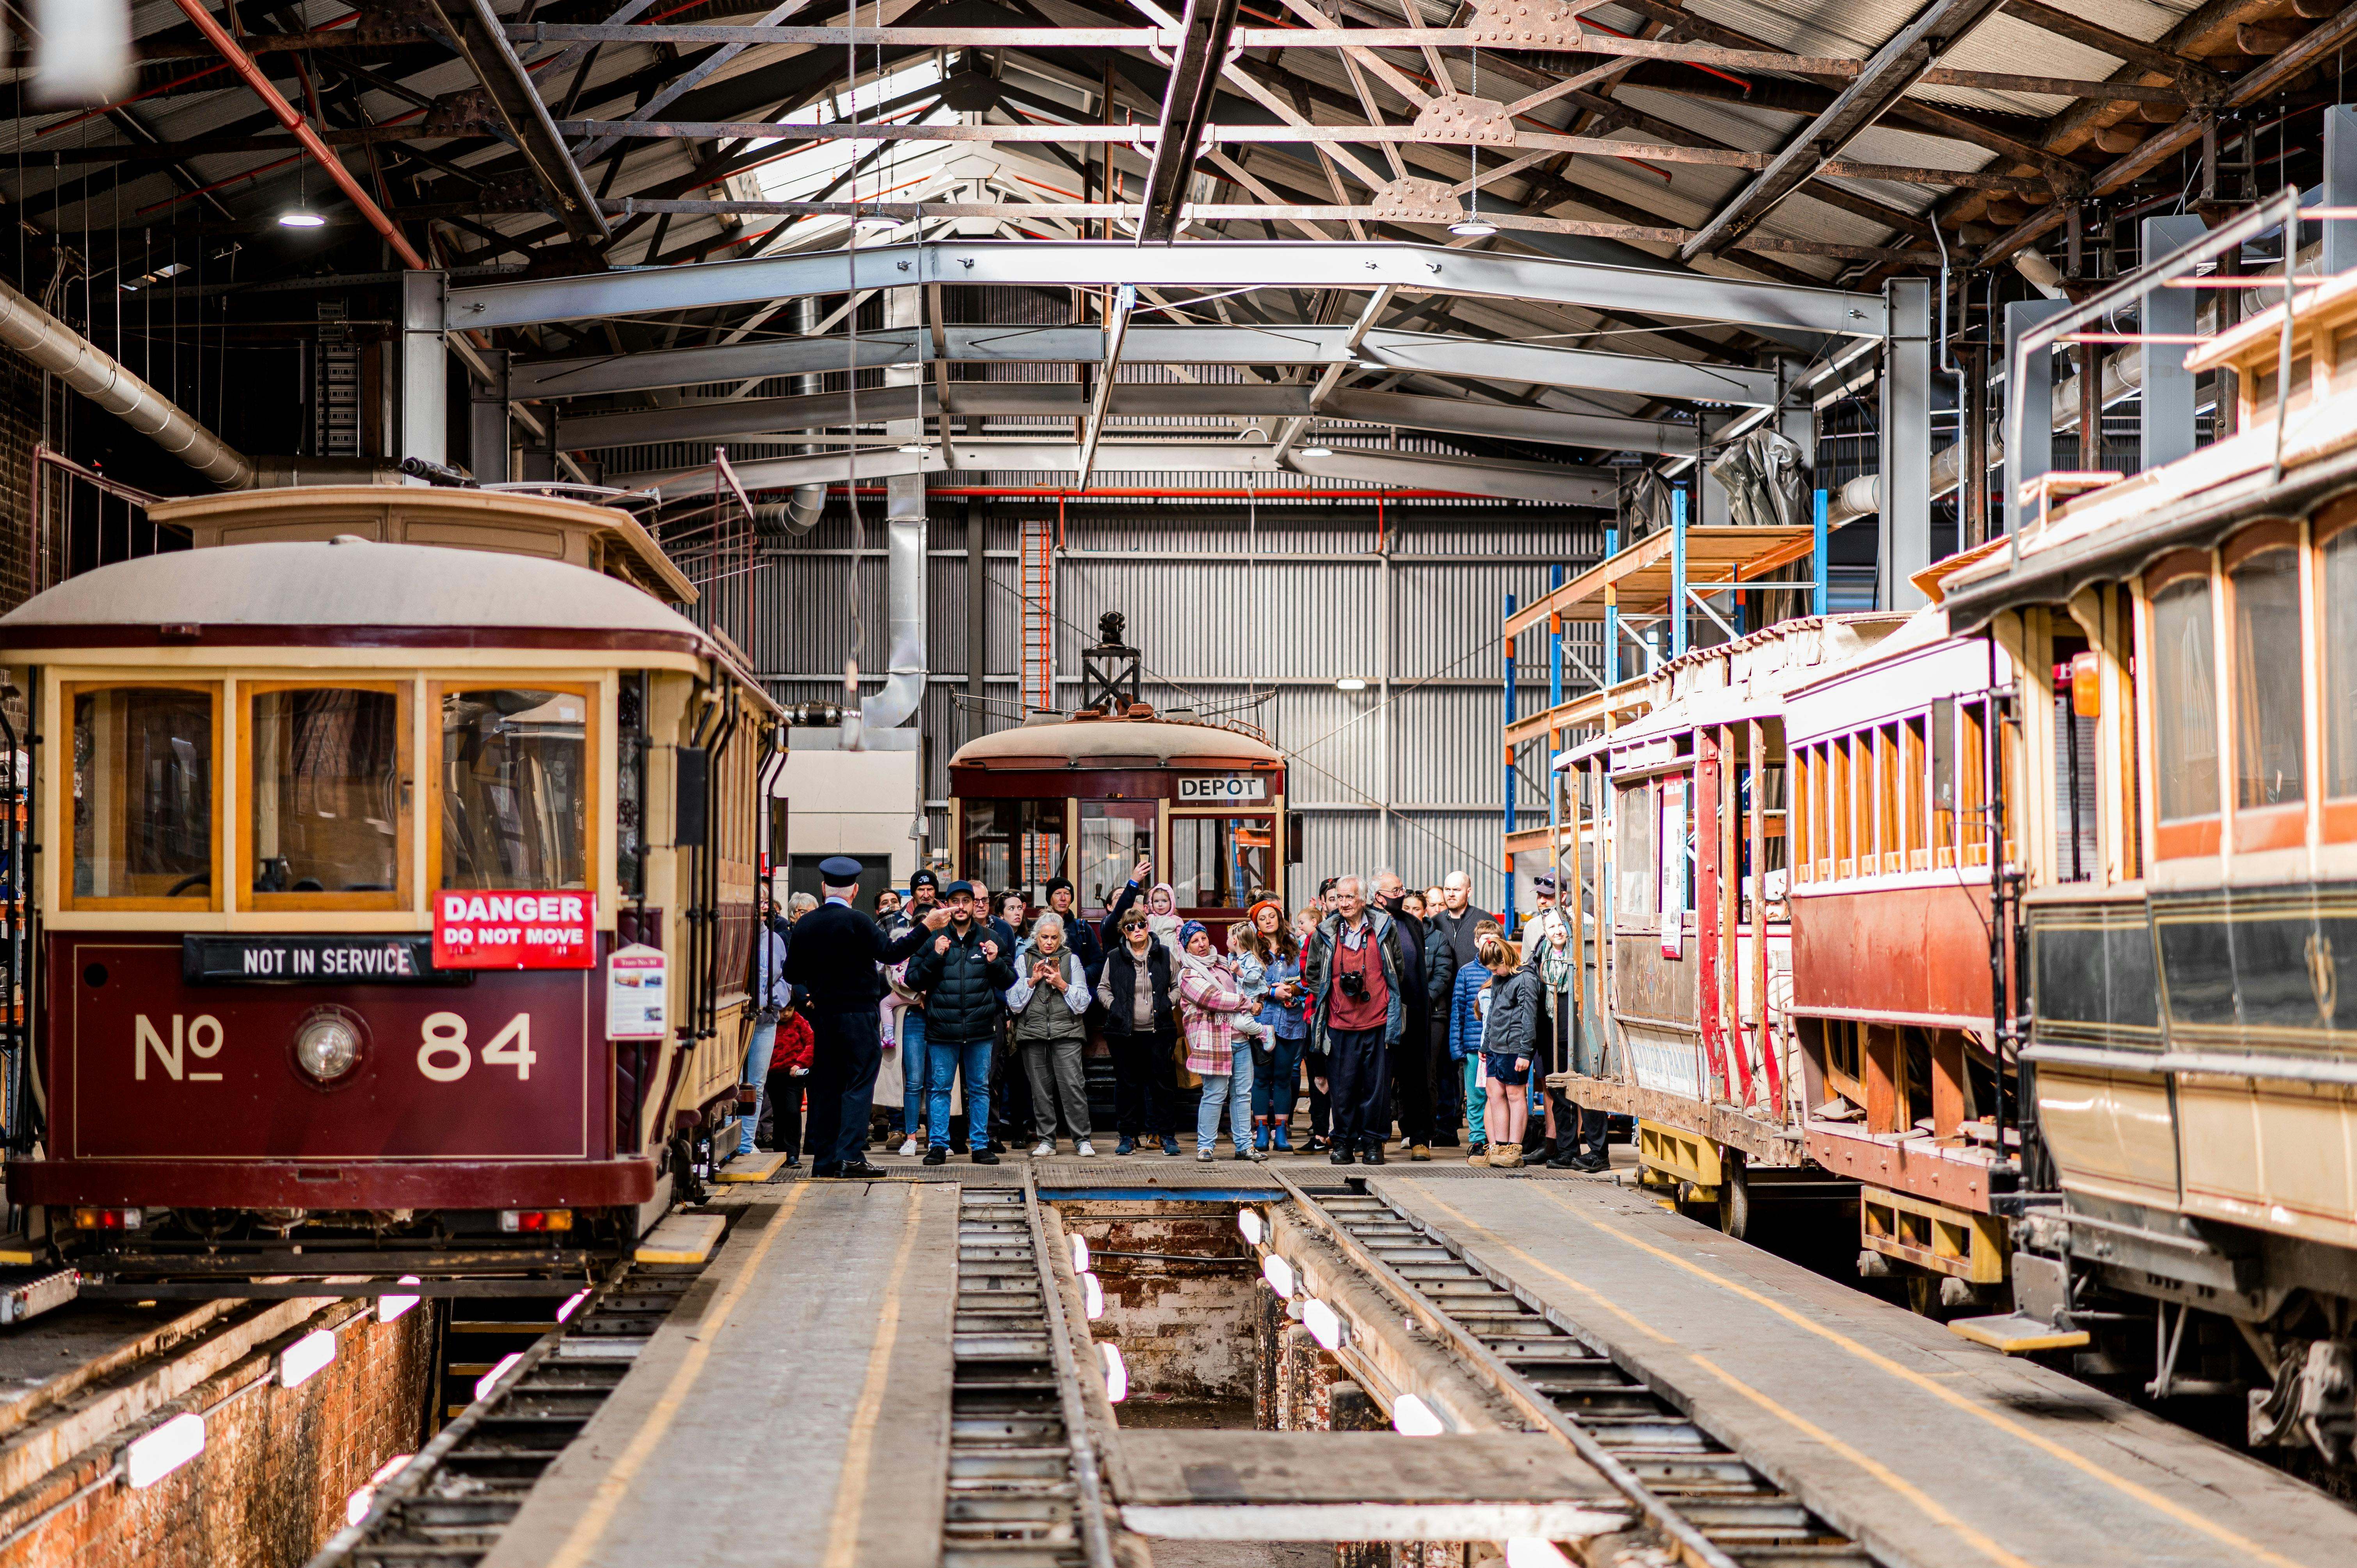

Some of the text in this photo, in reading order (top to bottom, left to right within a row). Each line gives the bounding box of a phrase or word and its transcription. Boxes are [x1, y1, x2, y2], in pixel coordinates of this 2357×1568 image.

[1182, 780, 1256, 796] DEPOT
[444, 896, 584, 922] DANGER
[444, 928, 584, 945] DO NOT MOVE
[244, 948, 410, 974] NOT IN SERVICE
[416, 1011, 537, 1082] 84
